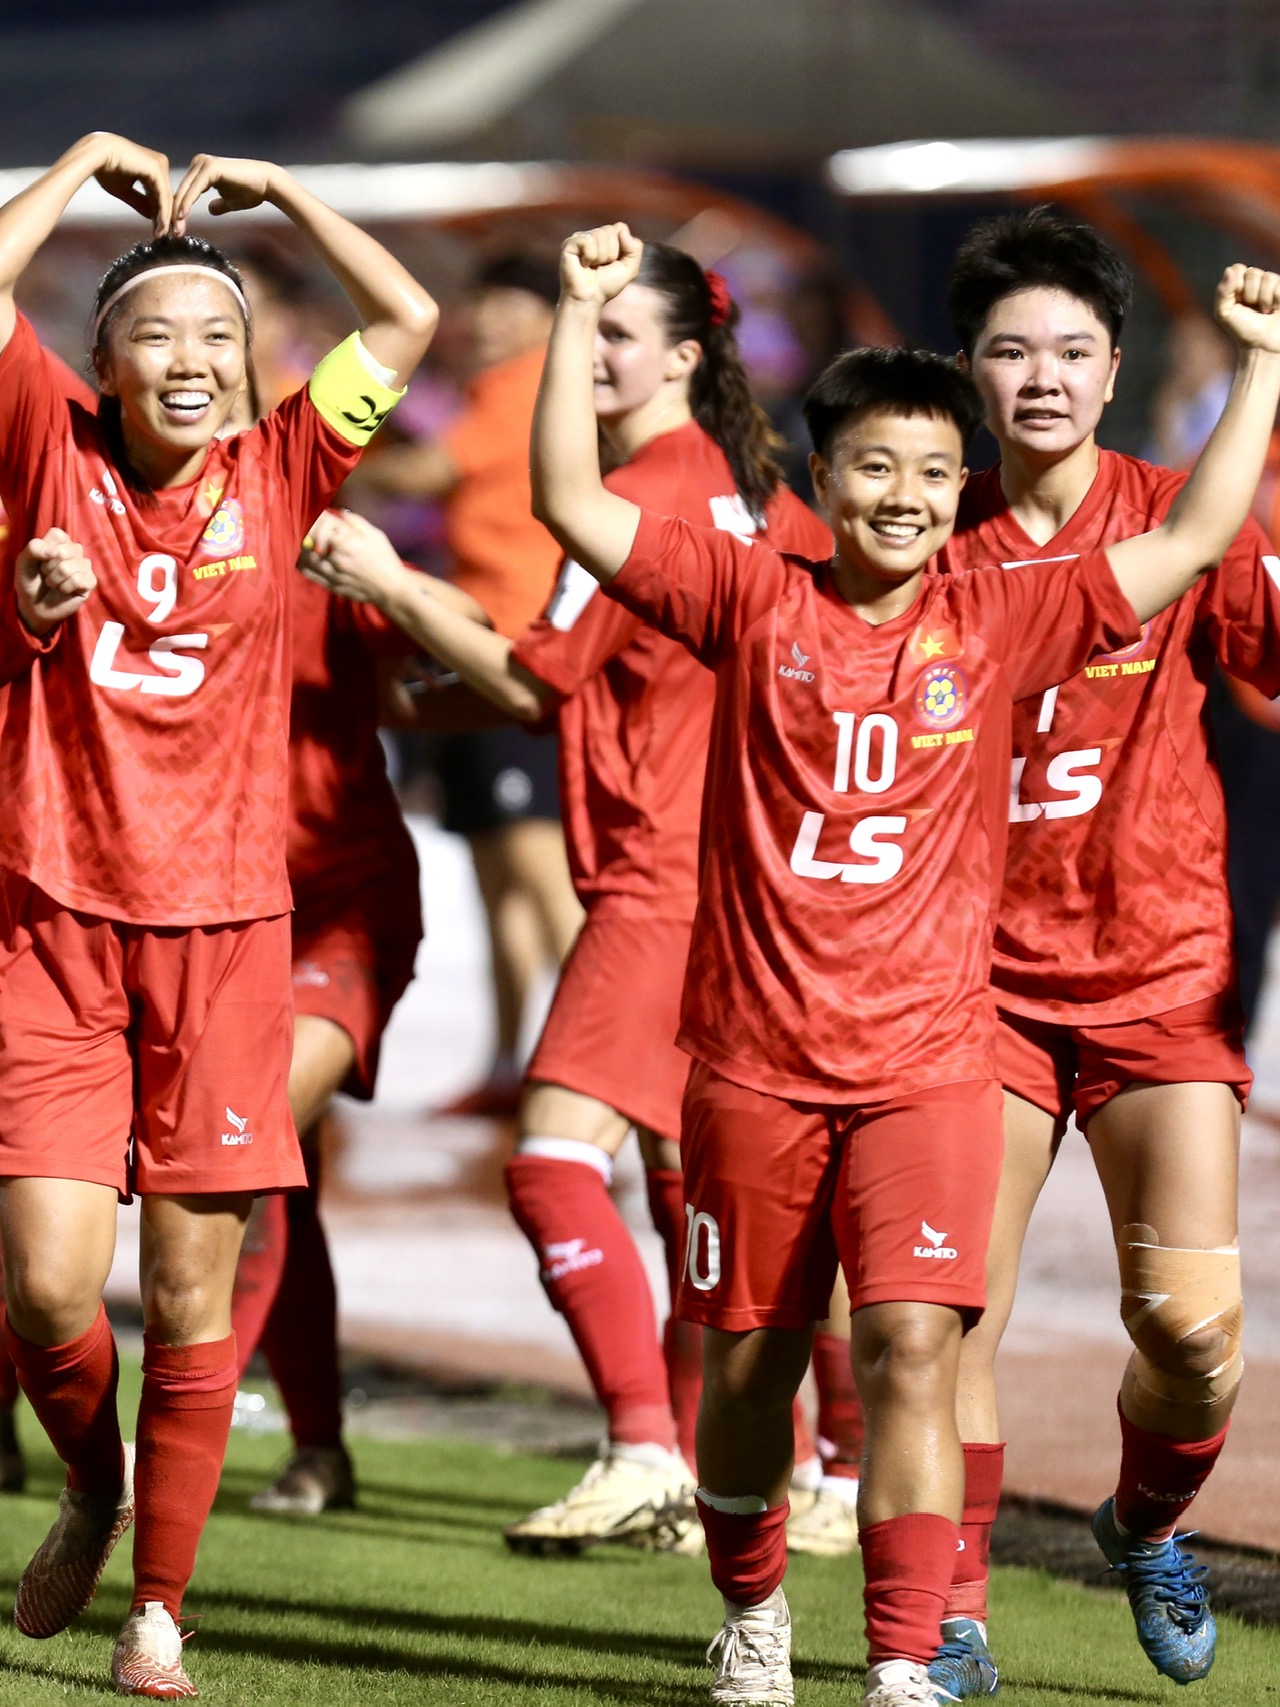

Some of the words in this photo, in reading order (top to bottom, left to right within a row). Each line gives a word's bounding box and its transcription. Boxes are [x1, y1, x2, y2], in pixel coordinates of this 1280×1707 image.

[137, 553, 178, 623] 9
[192, 560, 227, 581] VIET
[227, 555, 257, 571] NAM
[89, 620, 208, 697] LS
[1084, 664, 1119, 679] VIET
[1121, 658, 1156, 676] NAM
[832, 710, 899, 794] 10
[911, 733, 944, 749] VIET
[945, 728, 975, 745] NAM
[1007, 747, 1103, 823] LS
[790, 810, 907, 884] LS
[221, 1133, 253, 1146] KAMITO
[913, 1245, 959, 1260] KAMITO
